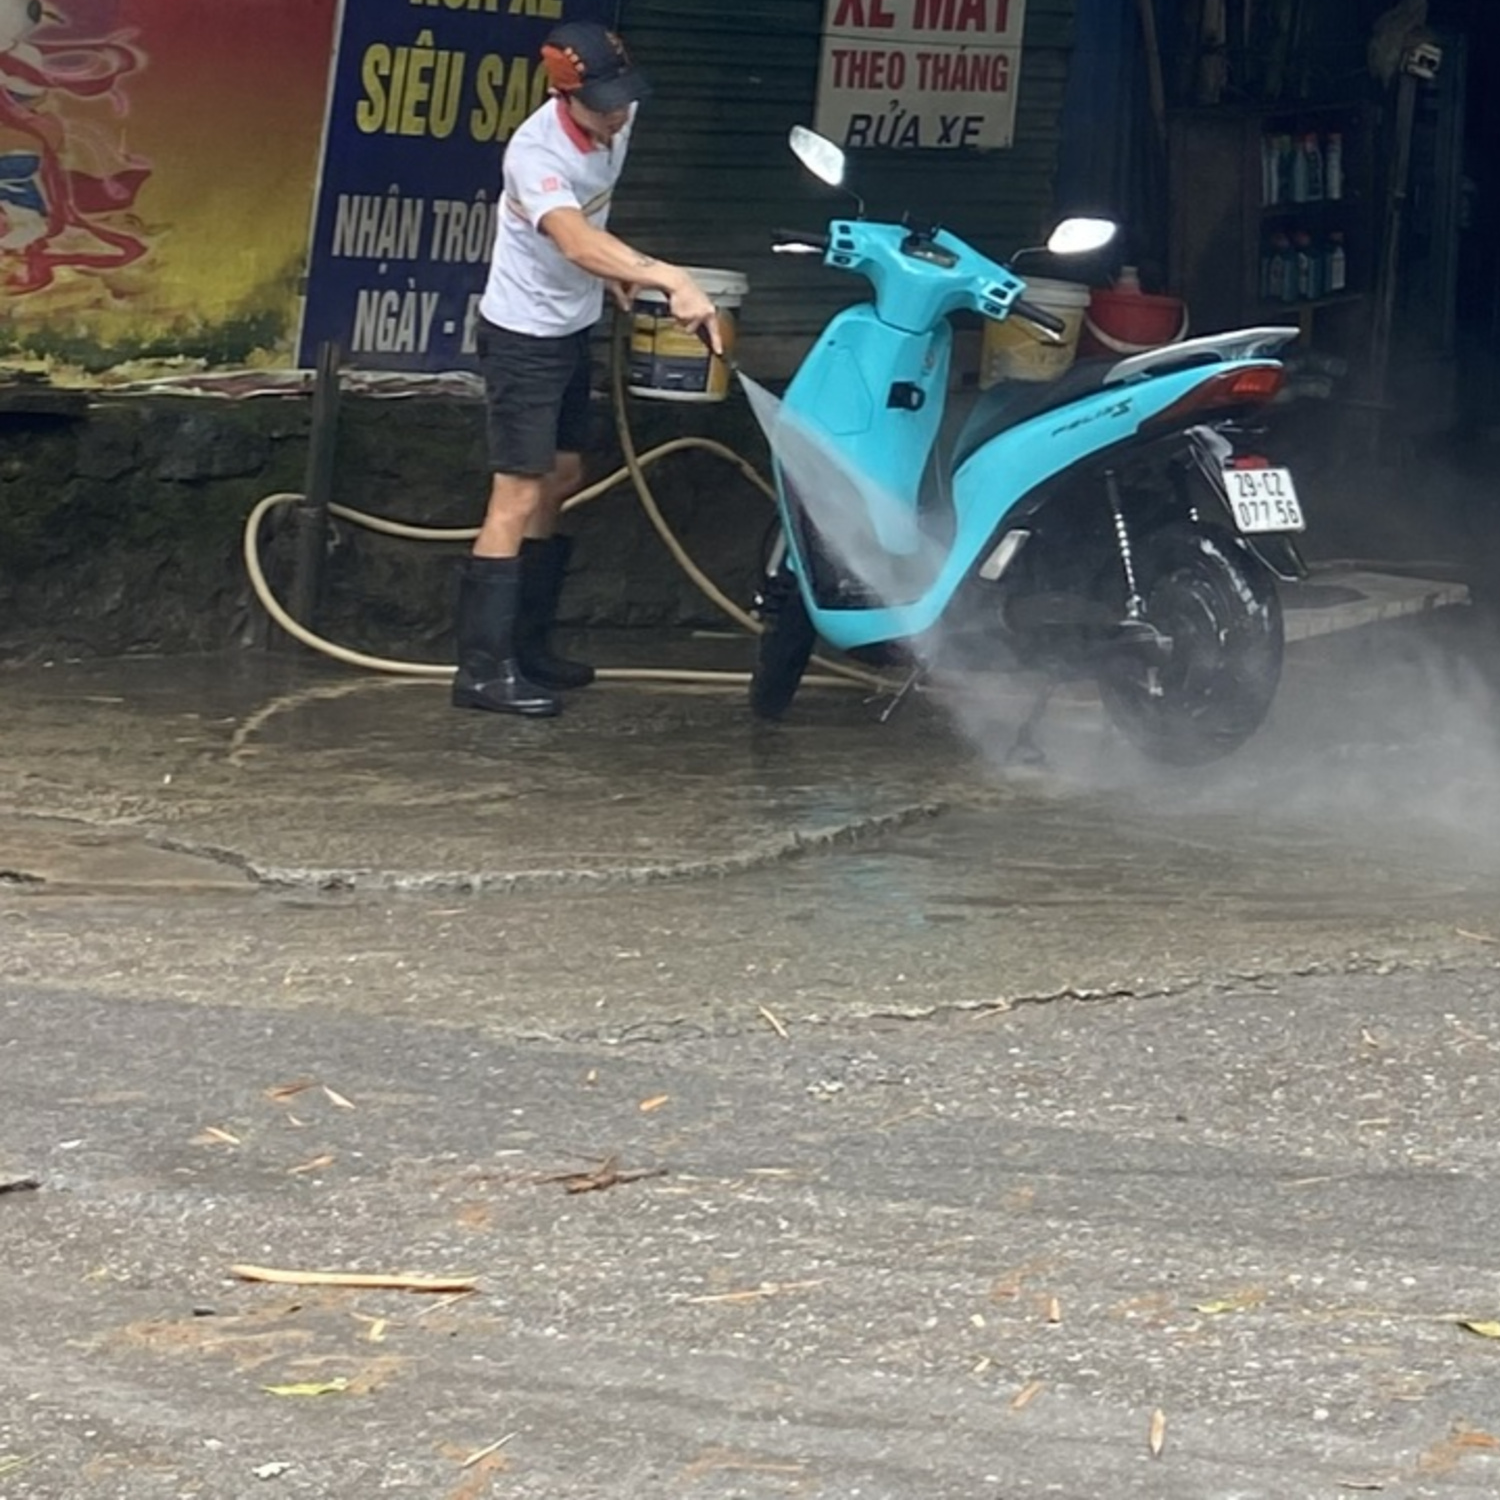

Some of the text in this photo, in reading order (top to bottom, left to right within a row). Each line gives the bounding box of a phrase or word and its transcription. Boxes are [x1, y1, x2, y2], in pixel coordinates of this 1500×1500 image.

[355, 29, 466, 139] SIÊU
[831, 45, 1009, 92] THEO THÁNG
[846, 99, 985, 148] RỬA XE
[331, 183, 424, 274] NHẬN
[352, 278, 439, 353] NGÀY
